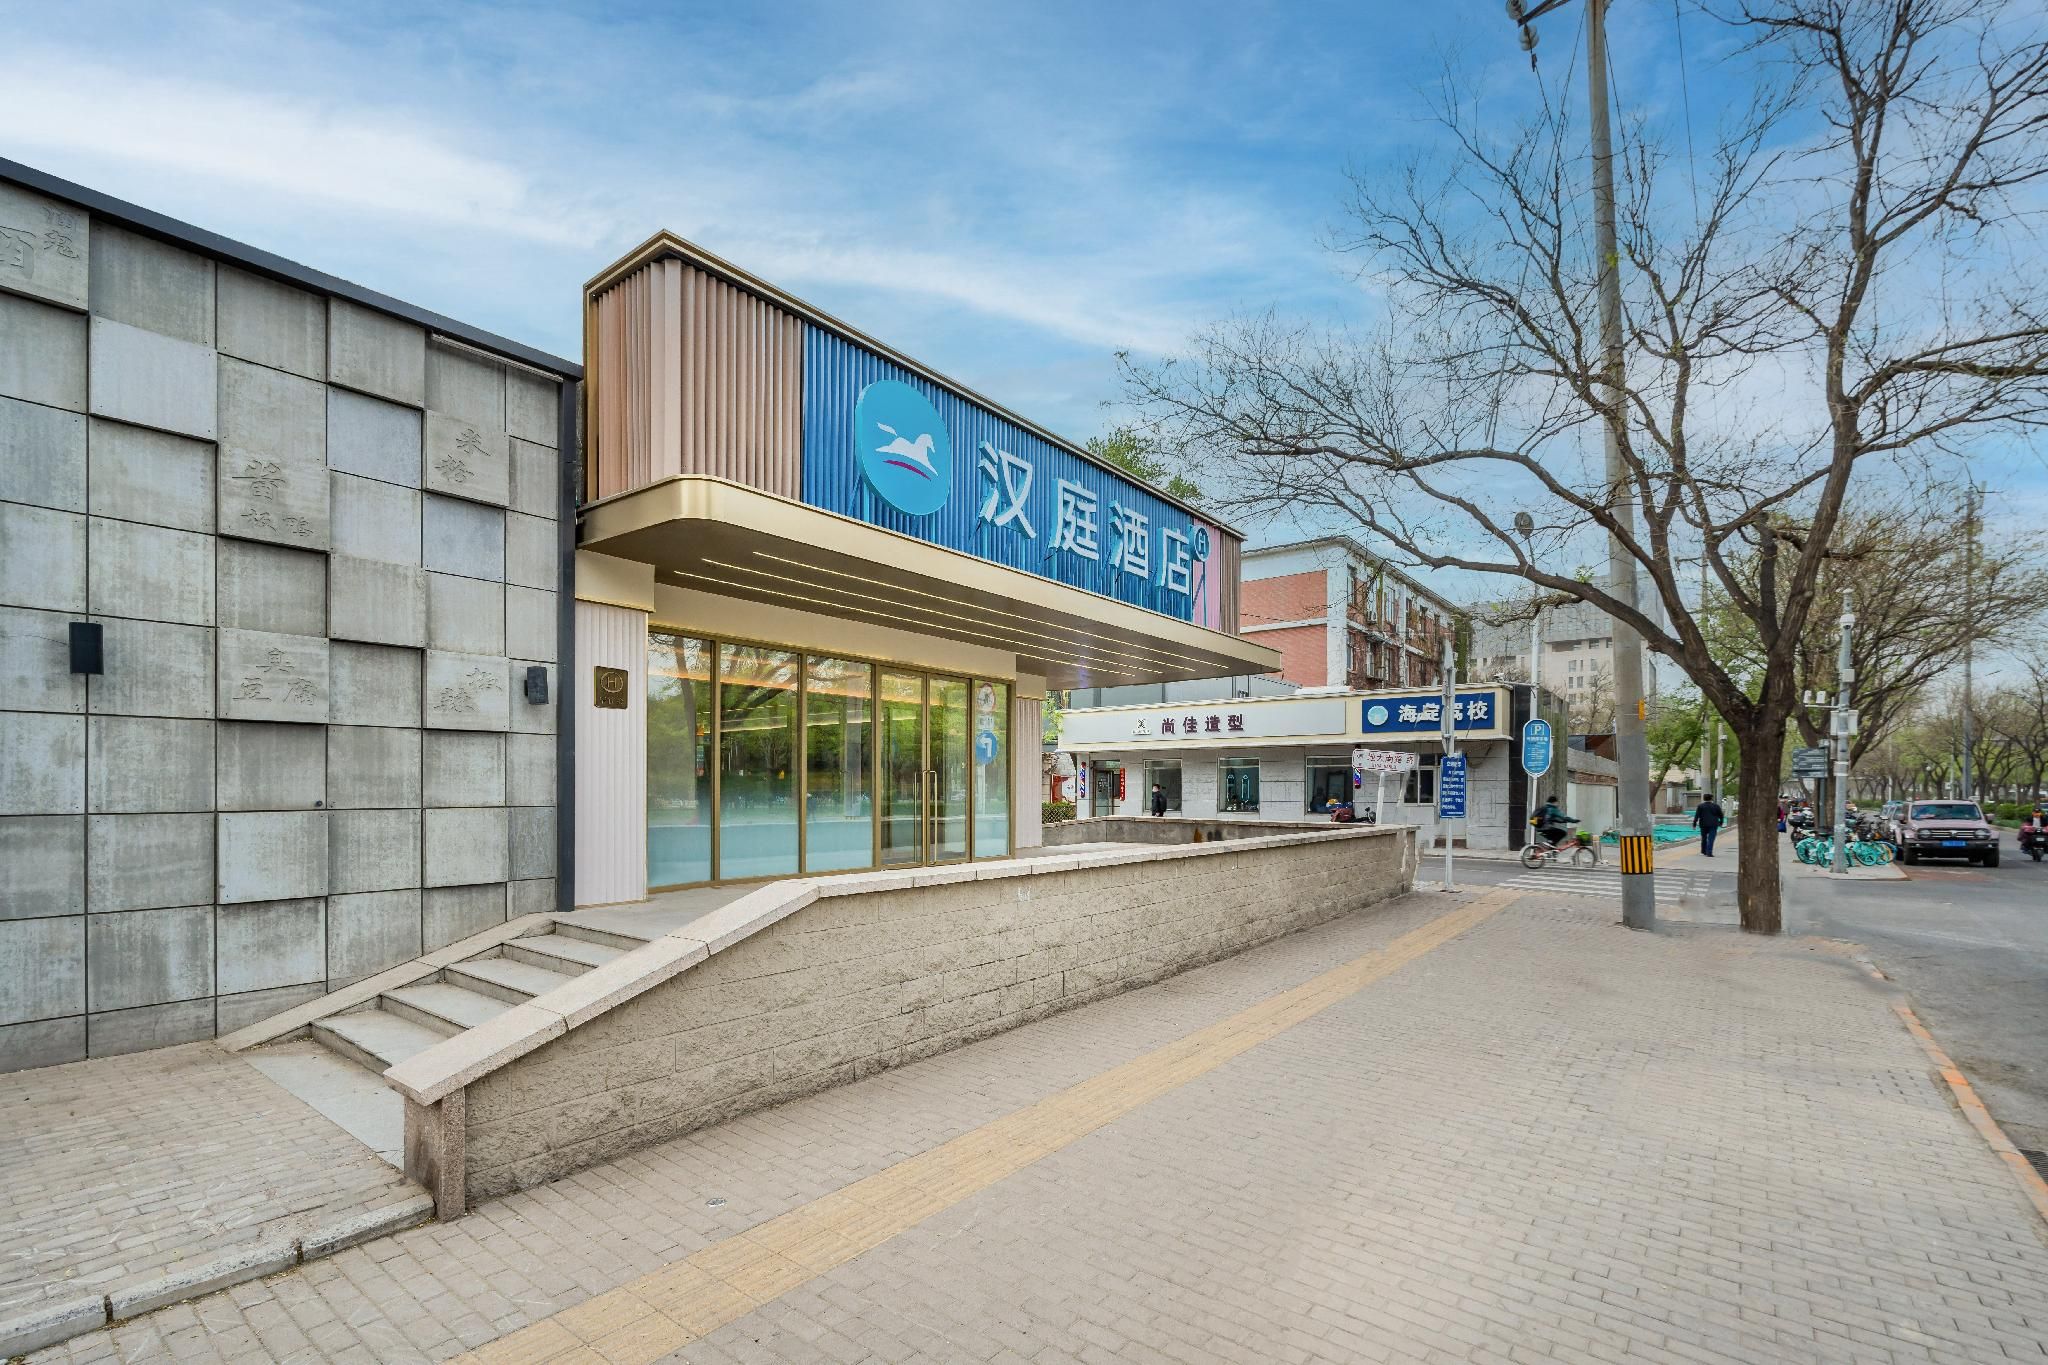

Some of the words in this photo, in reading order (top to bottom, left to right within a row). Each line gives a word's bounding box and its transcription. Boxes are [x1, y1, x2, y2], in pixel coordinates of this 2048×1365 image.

[978, 440, 1190, 596] 汉庭酒店
[1161, 713, 1244, 735] 尚佳造型
